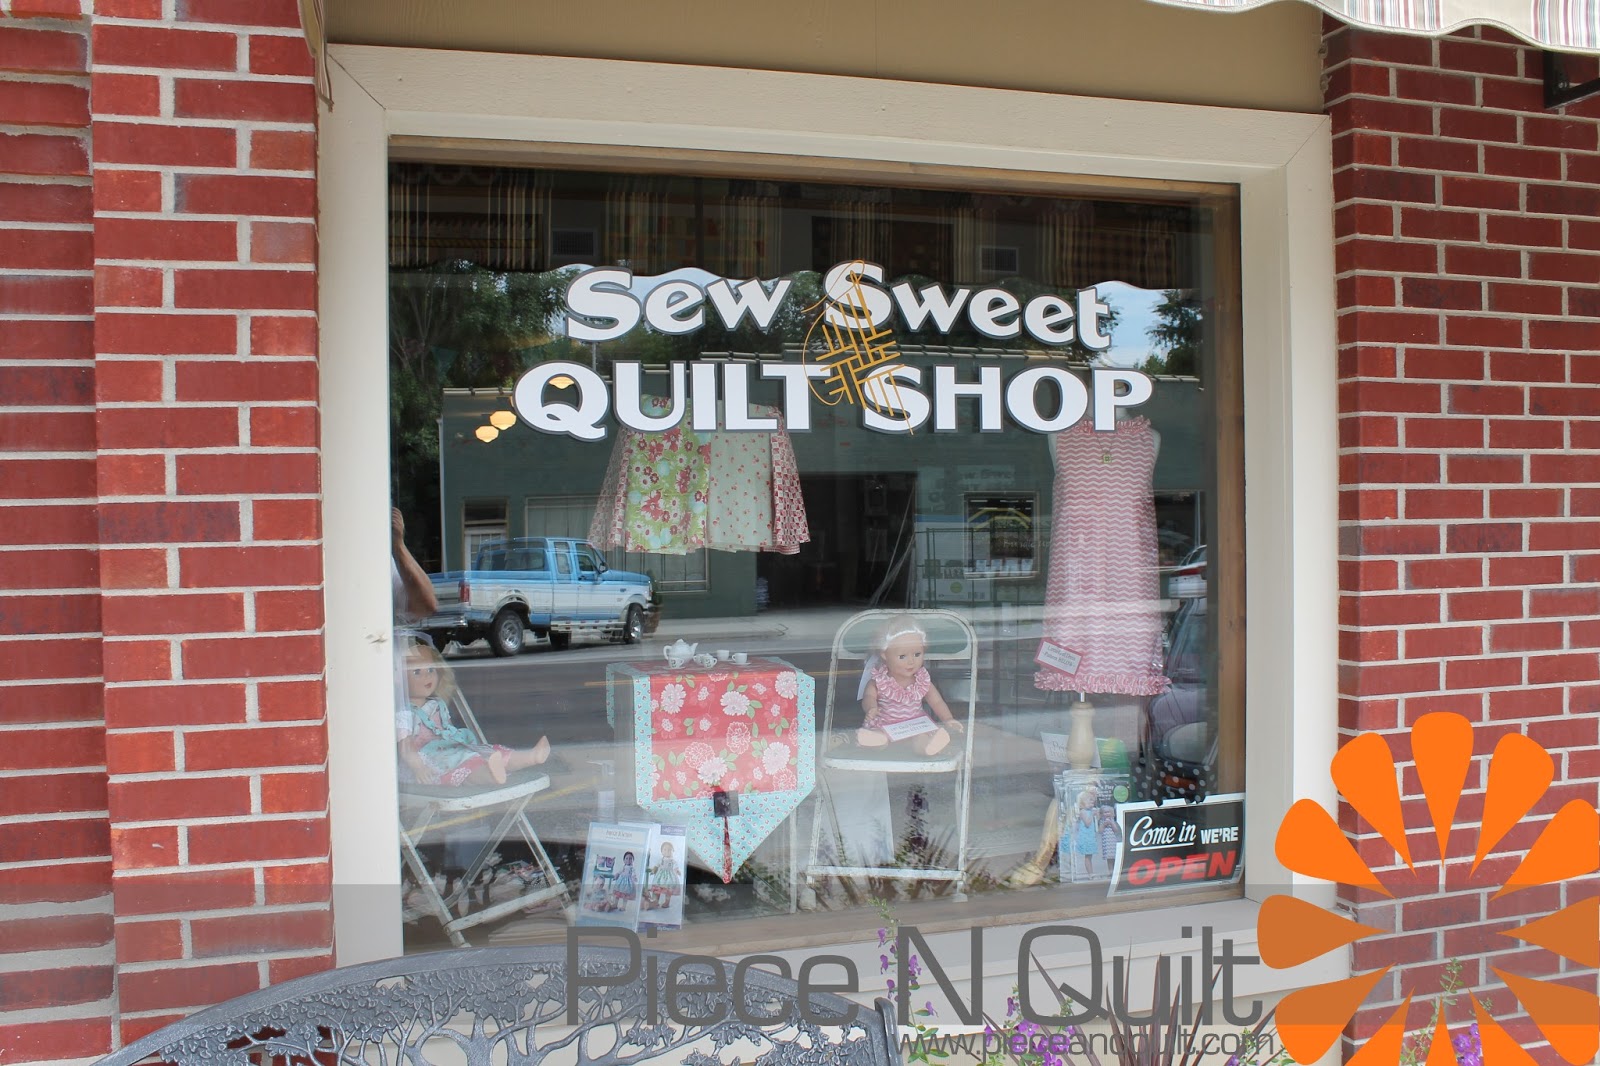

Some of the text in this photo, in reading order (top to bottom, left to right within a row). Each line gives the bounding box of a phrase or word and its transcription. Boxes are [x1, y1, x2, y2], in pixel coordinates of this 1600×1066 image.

[565, 260, 1112, 351] Sew Sweet
[513, 360, 1155, 443] QUILT SHOP
[1129, 815, 1239, 846] Come in WE'RE
[1127, 850, 1236, 885] OPEN
